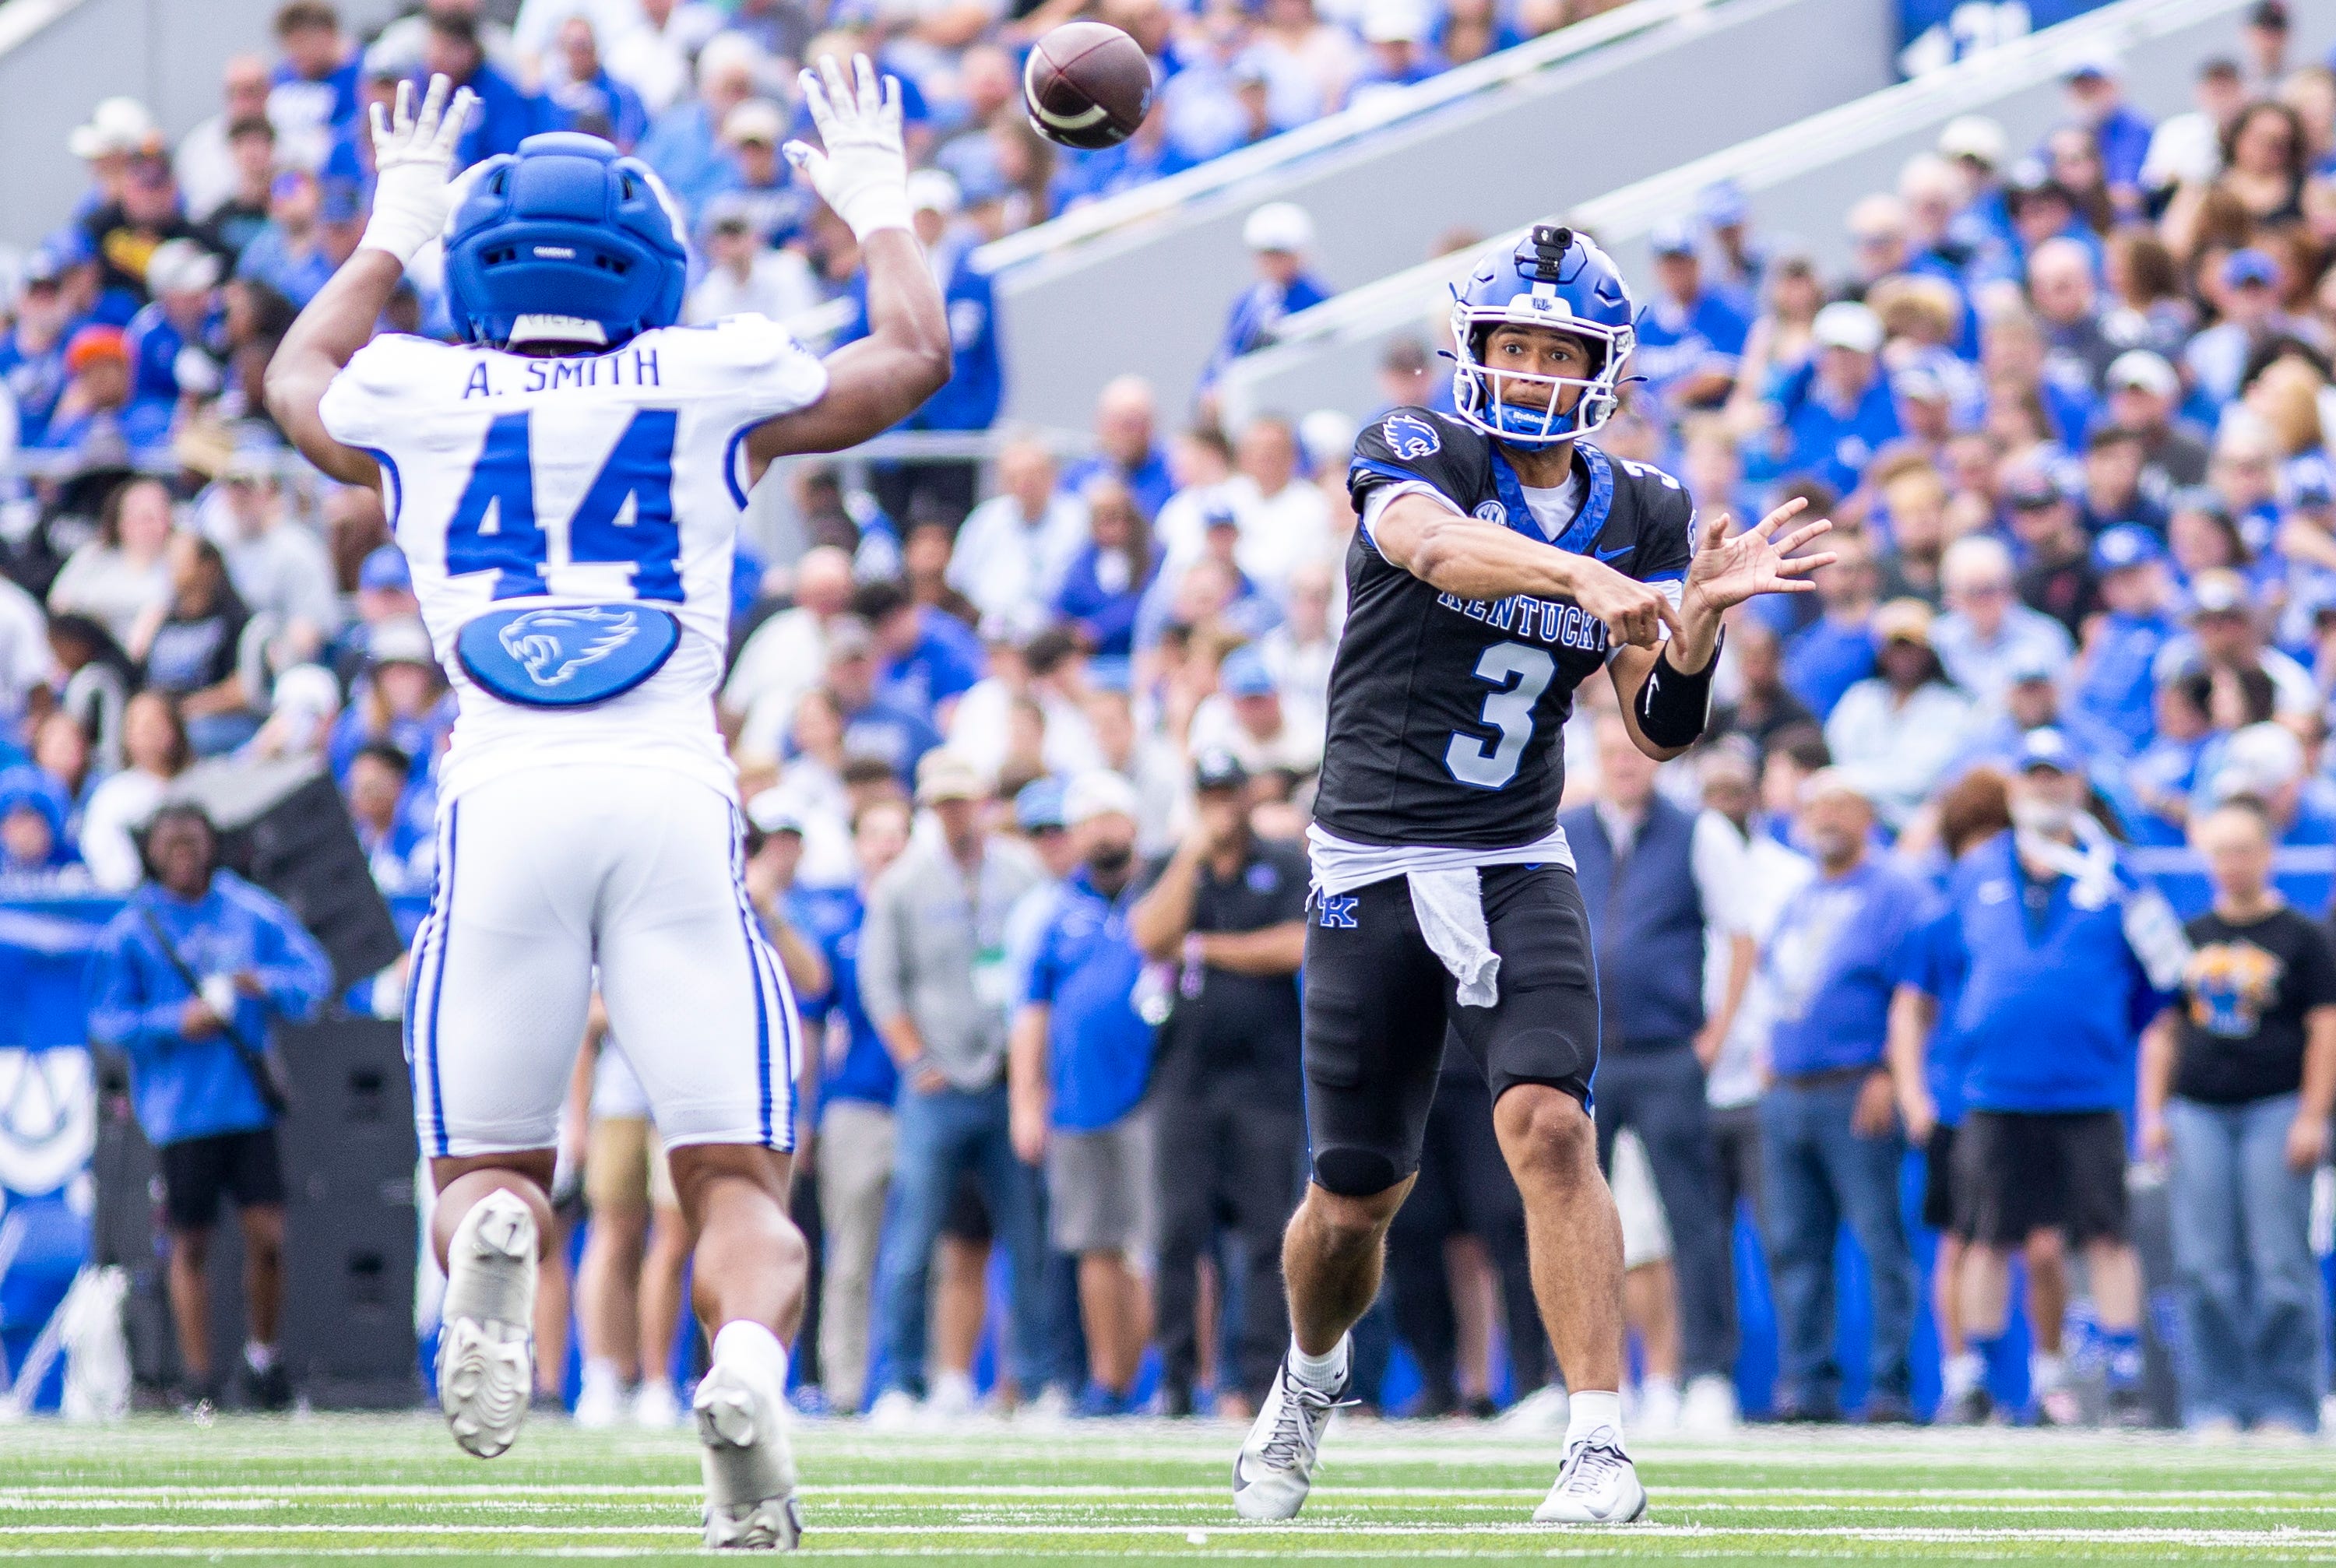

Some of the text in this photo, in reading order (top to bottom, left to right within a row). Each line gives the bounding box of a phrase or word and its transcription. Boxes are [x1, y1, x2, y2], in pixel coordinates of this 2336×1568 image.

[461, 348, 660, 399] A. SMITH
[445, 408, 685, 603] 44
[1442, 639, 1560, 791] 3
